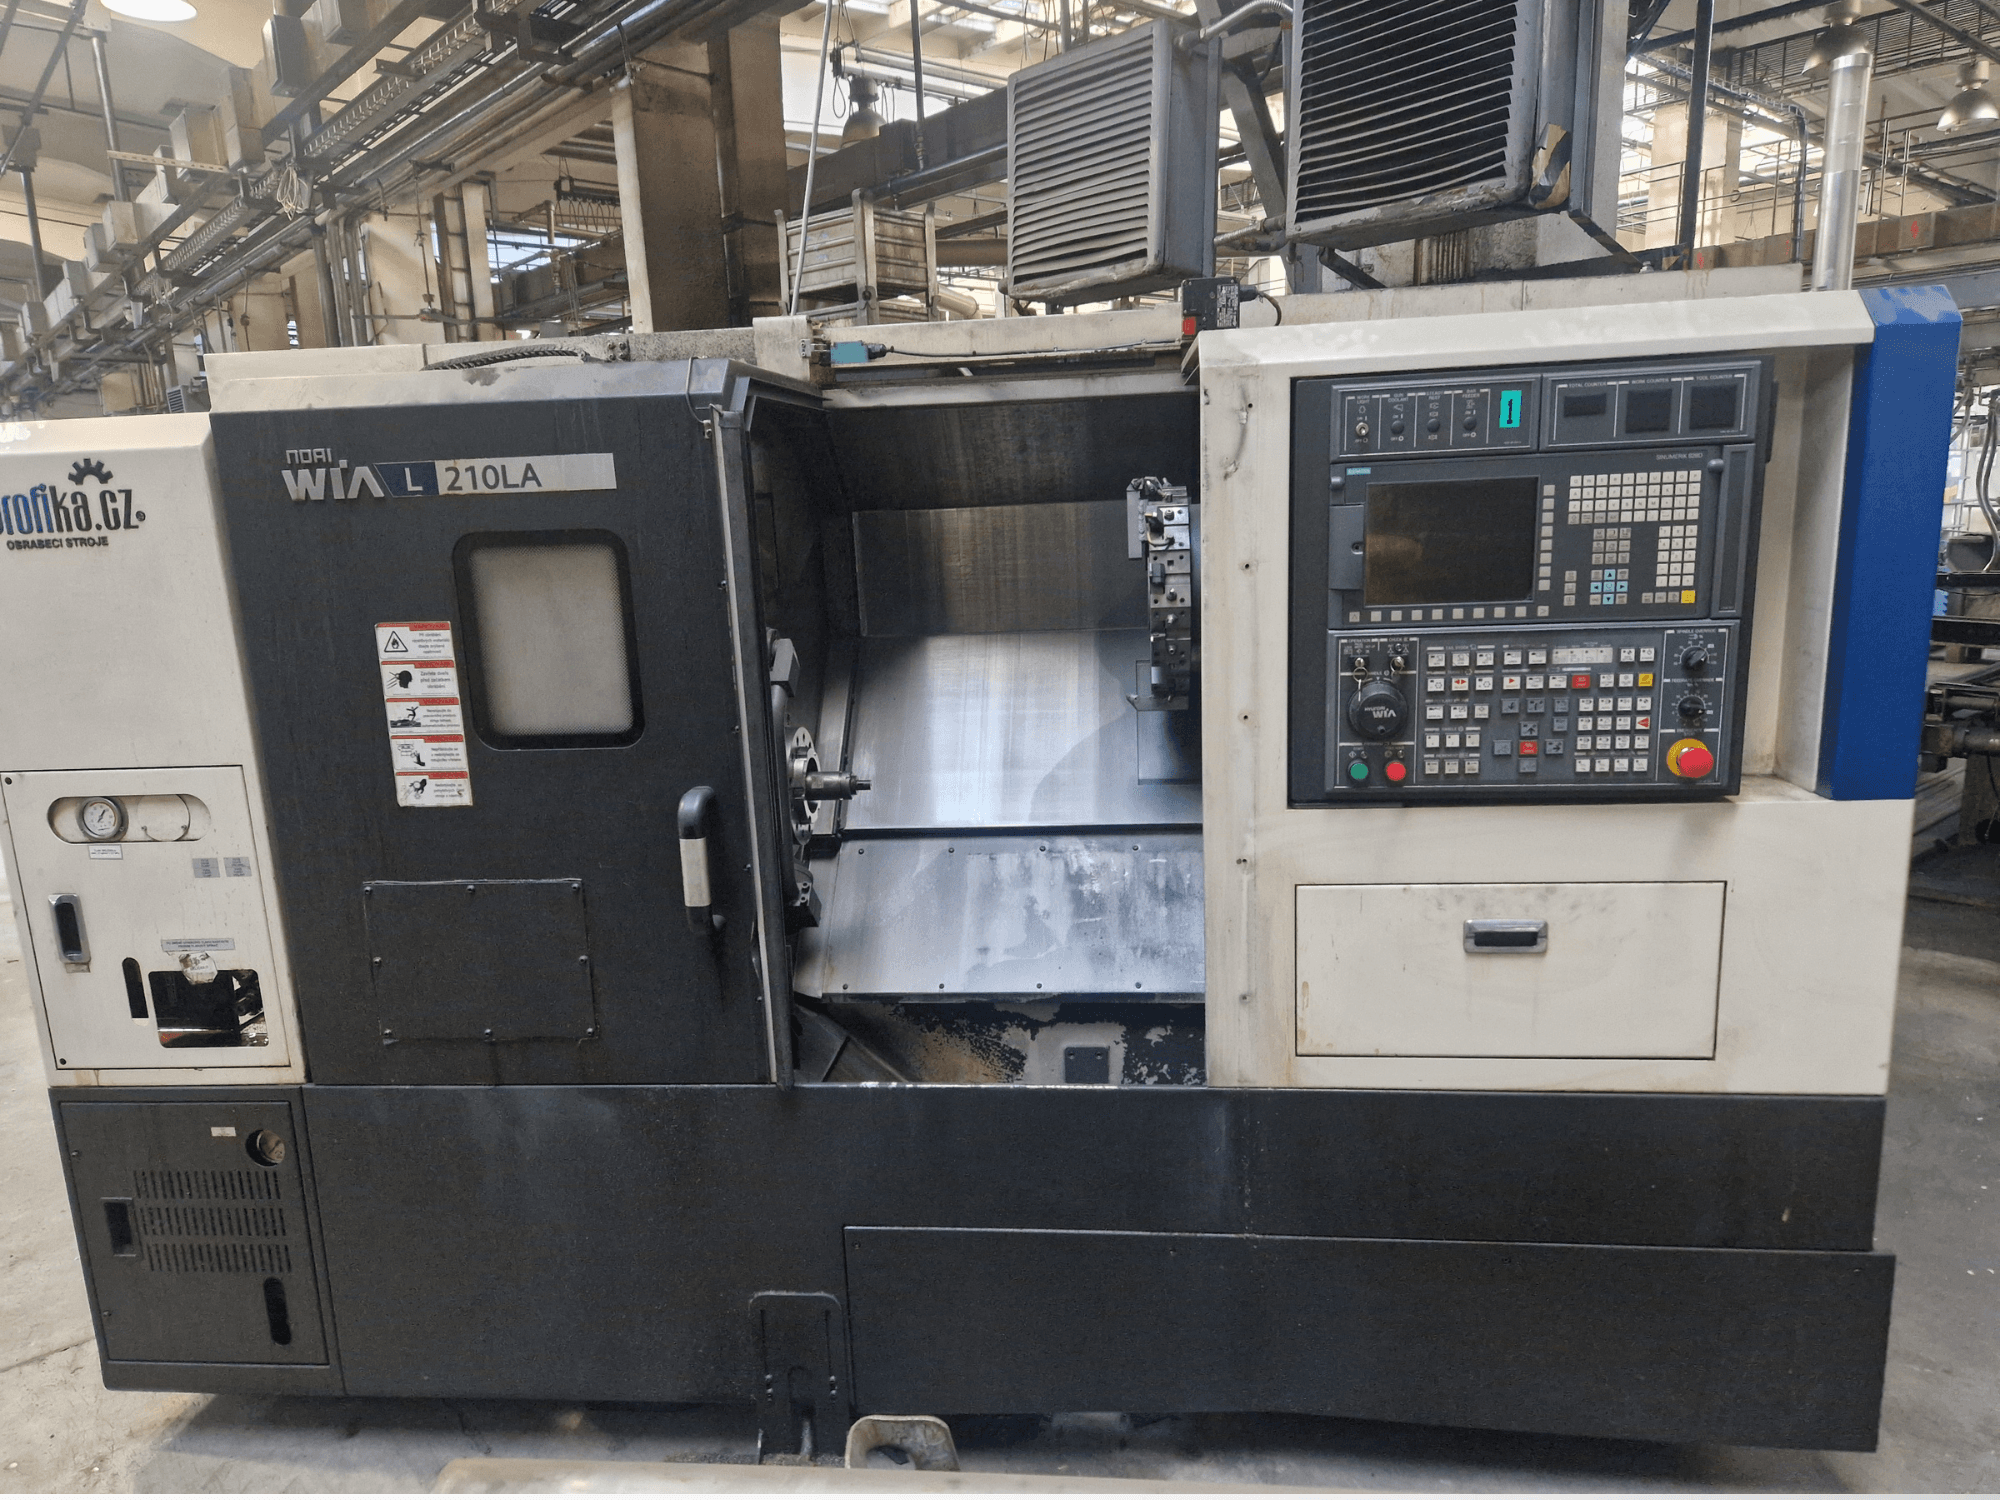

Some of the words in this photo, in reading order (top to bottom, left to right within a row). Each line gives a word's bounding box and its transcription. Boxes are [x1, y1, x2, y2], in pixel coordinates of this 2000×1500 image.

[404, 467, 423, 491] L
[444, 463, 543, 491] 210LA
[0, 483, 139, 535] rofika.cz
[66, 536, 109, 548] STROJE
